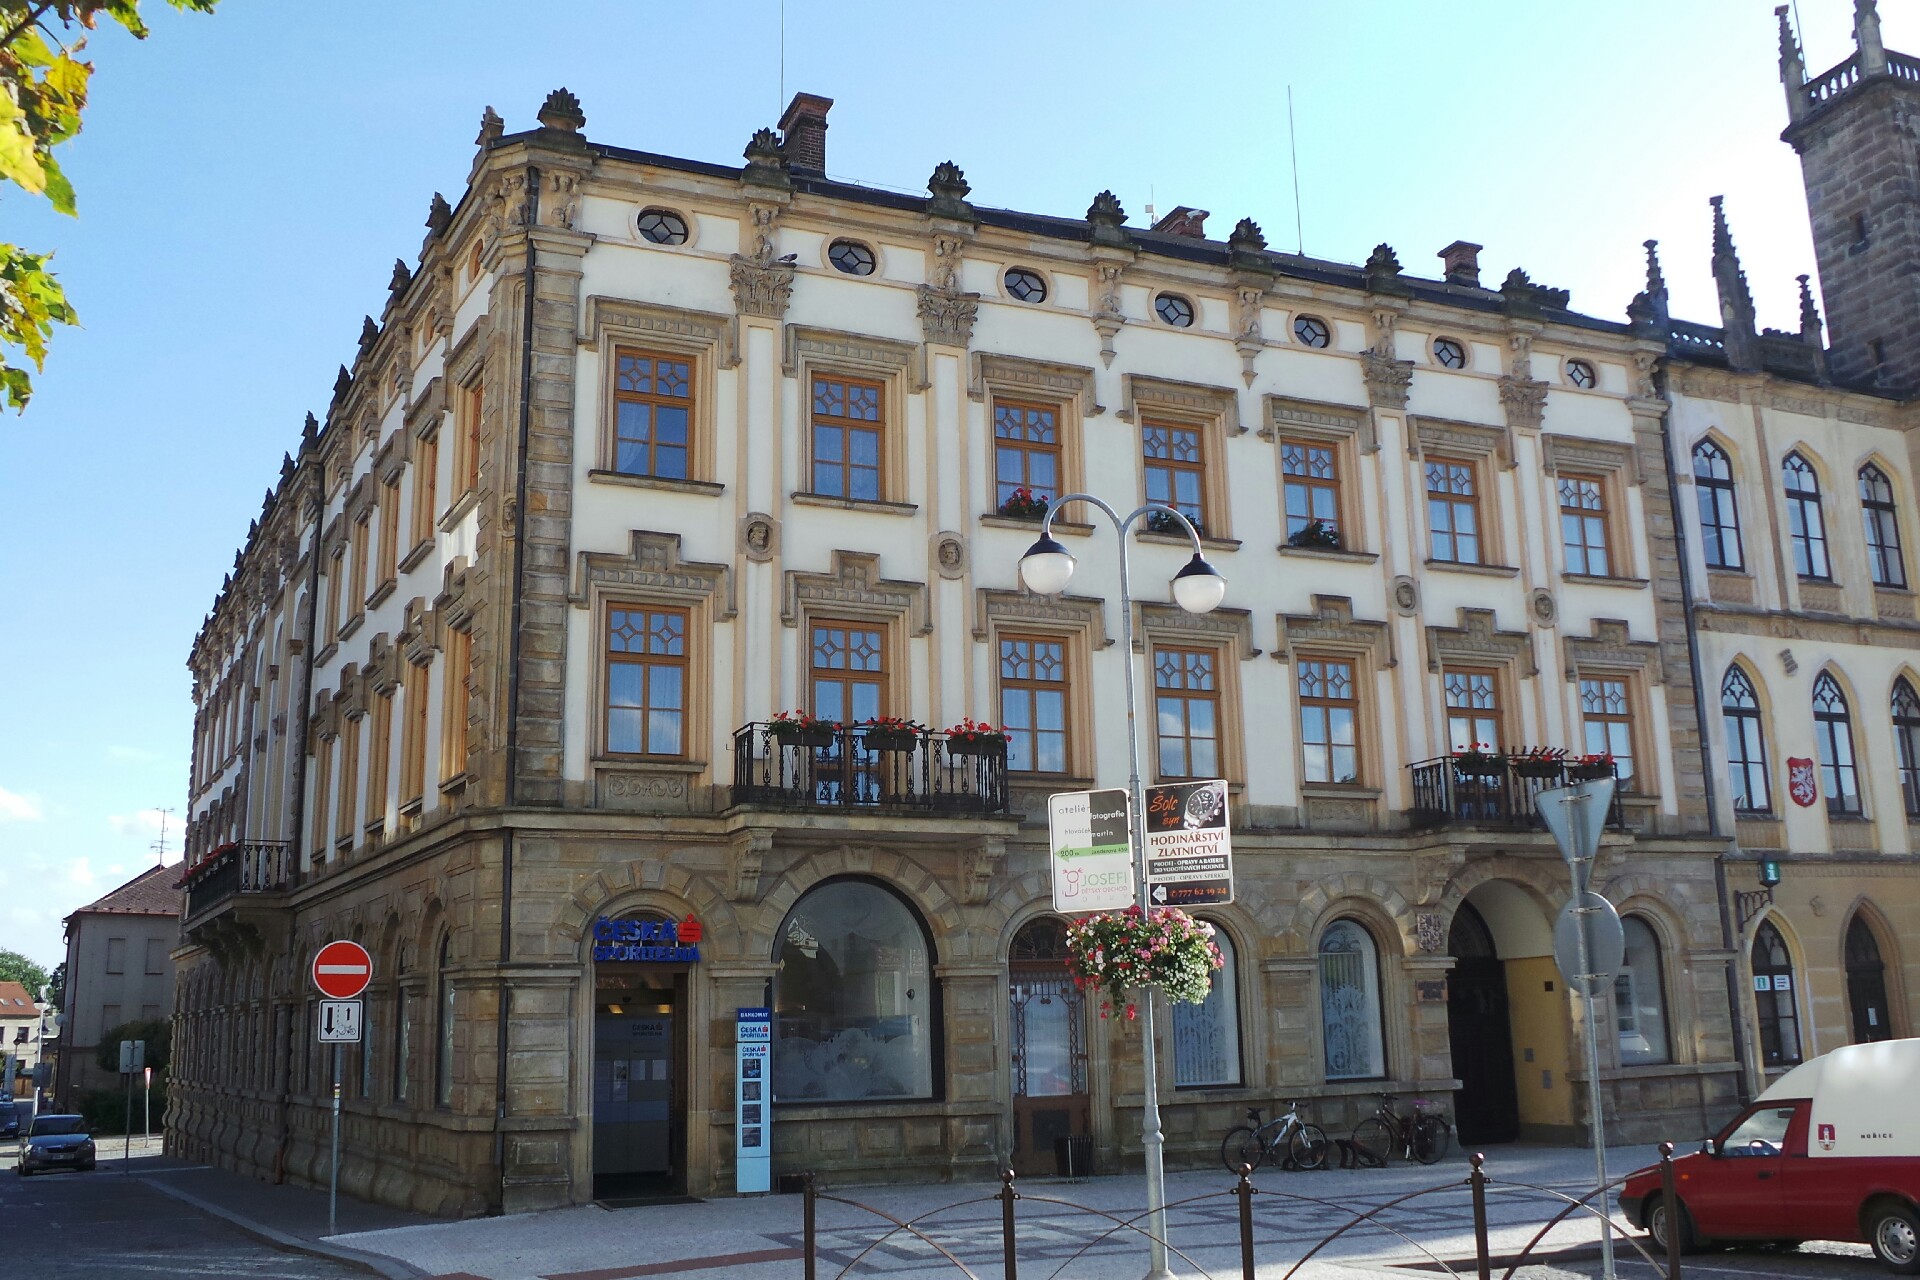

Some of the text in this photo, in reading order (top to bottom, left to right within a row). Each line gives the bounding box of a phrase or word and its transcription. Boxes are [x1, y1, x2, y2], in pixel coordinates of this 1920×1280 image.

[1149, 790, 1178, 812] Šolc
[1090, 810, 1125, 821] fotografie
[1150, 830, 1224, 846] HODINÁŘSTVÍ
[1060, 849, 1074, 857] 200
[1158, 842, 1218, 858] ZLATNICTVÍ
[1081, 872, 1127, 887] JOSEFI
[1179, 889, 1193, 898] 777
[1194, 888, 1204, 896] 62
[1217, 887, 1227, 895] 24
[593, 915, 677, 941] ČESKÁ
[593, 944, 701, 962] SPOŘITELNA
[740, 1025, 762, 1033] ČESKÁ
